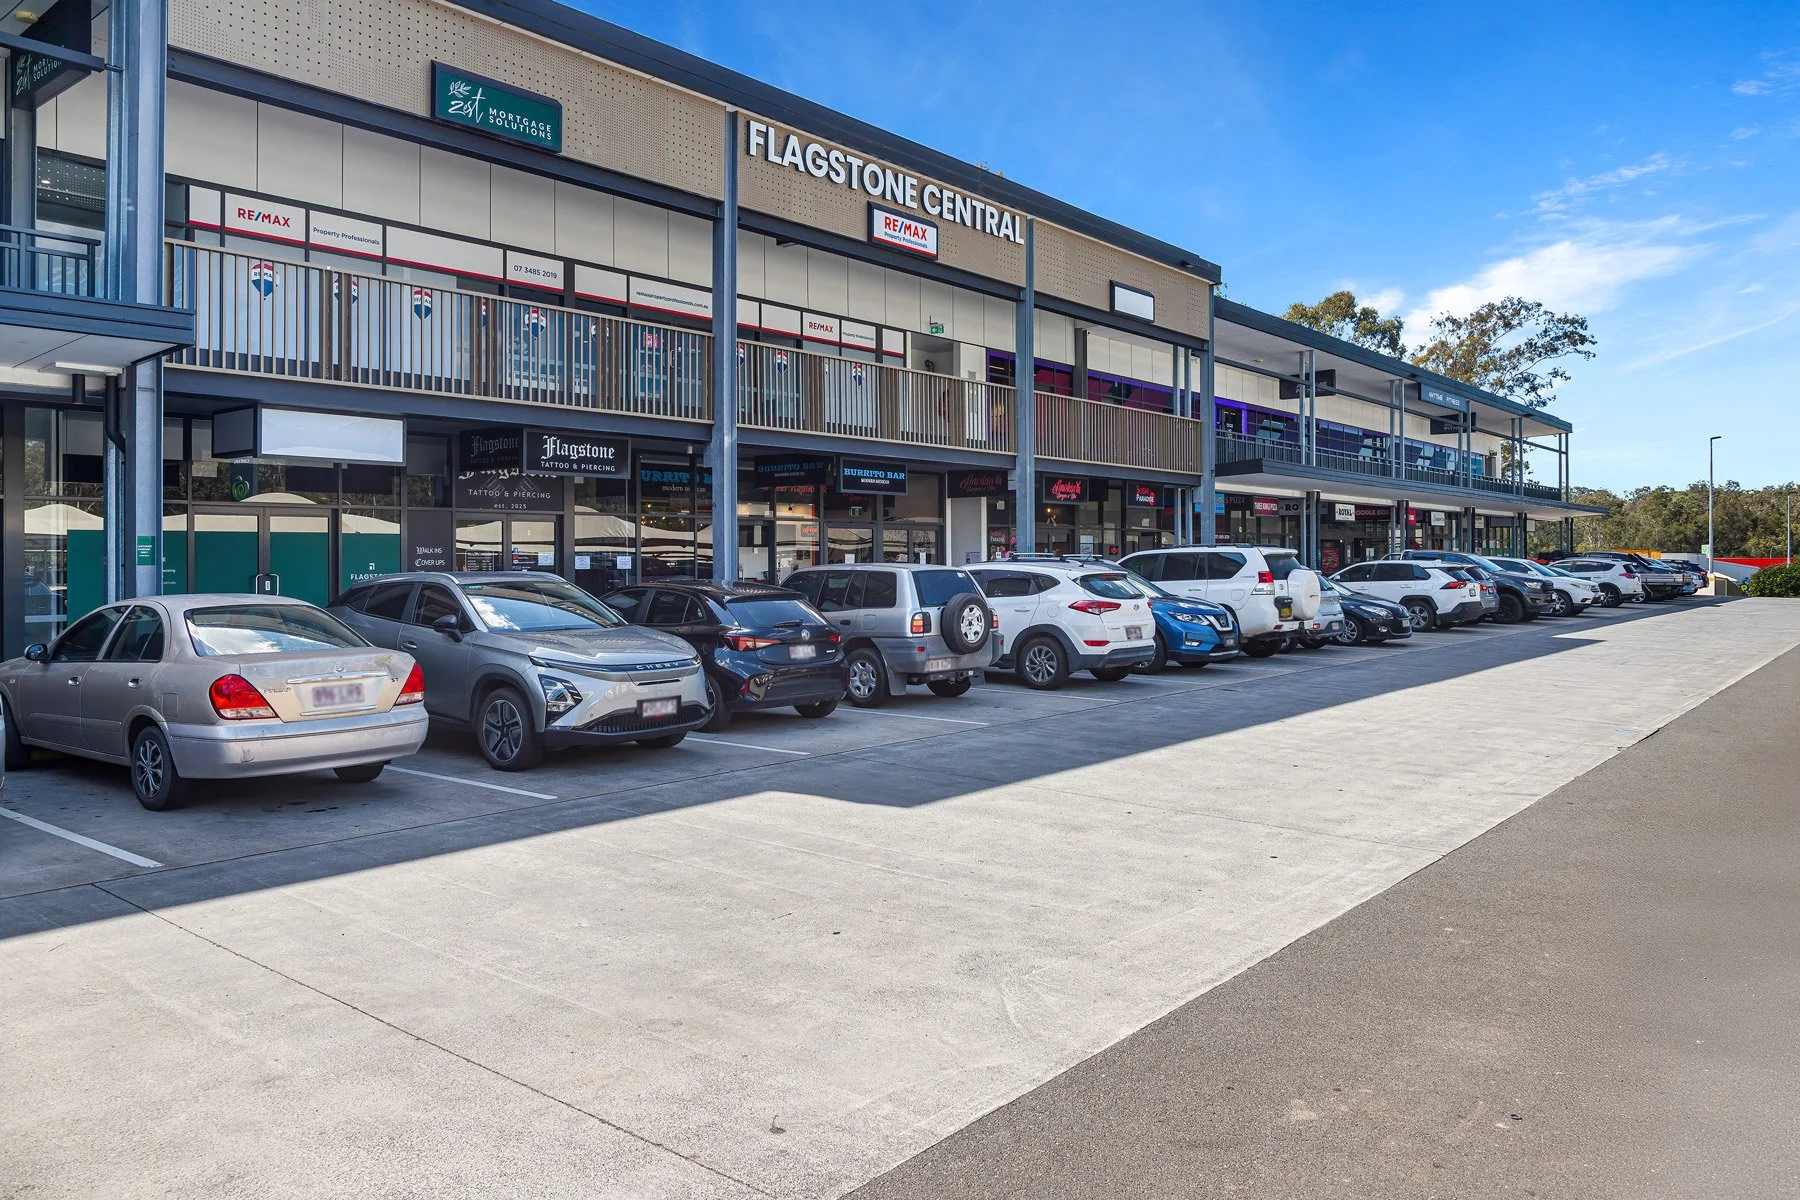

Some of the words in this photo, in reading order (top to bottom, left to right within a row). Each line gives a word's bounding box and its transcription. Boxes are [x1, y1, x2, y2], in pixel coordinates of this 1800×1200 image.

[489, 107, 552, 132] MORTGAGE
[488, 115, 552, 140] SOLUTIONS
[748, 120, 918, 209] FLAGSTONE
[923, 184, 1024, 244] CENTRAL
[237, 207, 290, 228] RE/MAX
[313, 227, 340, 239] Property
[341, 233, 380, 246] Professionals
[884, 216, 928, 242] RE/MAX
[884, 231, 902, 242] Property
[903, 236, 928, 249] Professionals
[524, 267, 541, 276] 3485
[542, 270, 558, 279] 2019
[808, 321, 834, 334] RE/MAX
[541, 435, 615, 460] Flagstone
[541, 461, 569, 469] TATTOO
[582, 464, 616, 472] PIERCING
[758, 464, 800, 473] BURRITO
[803, 461, 825, 470] BAR
[843, 468, 885, 479] BURRITO
[887, 471, 905, 480] BAR
[468, 489, 500, 497] TATTOO
[513, 491, 551, 499] PIERCING
[416, 546, 433, 554] WALK
[415, 558, 434, 567] COVER
[636, 662, 679, 670] CHERY
